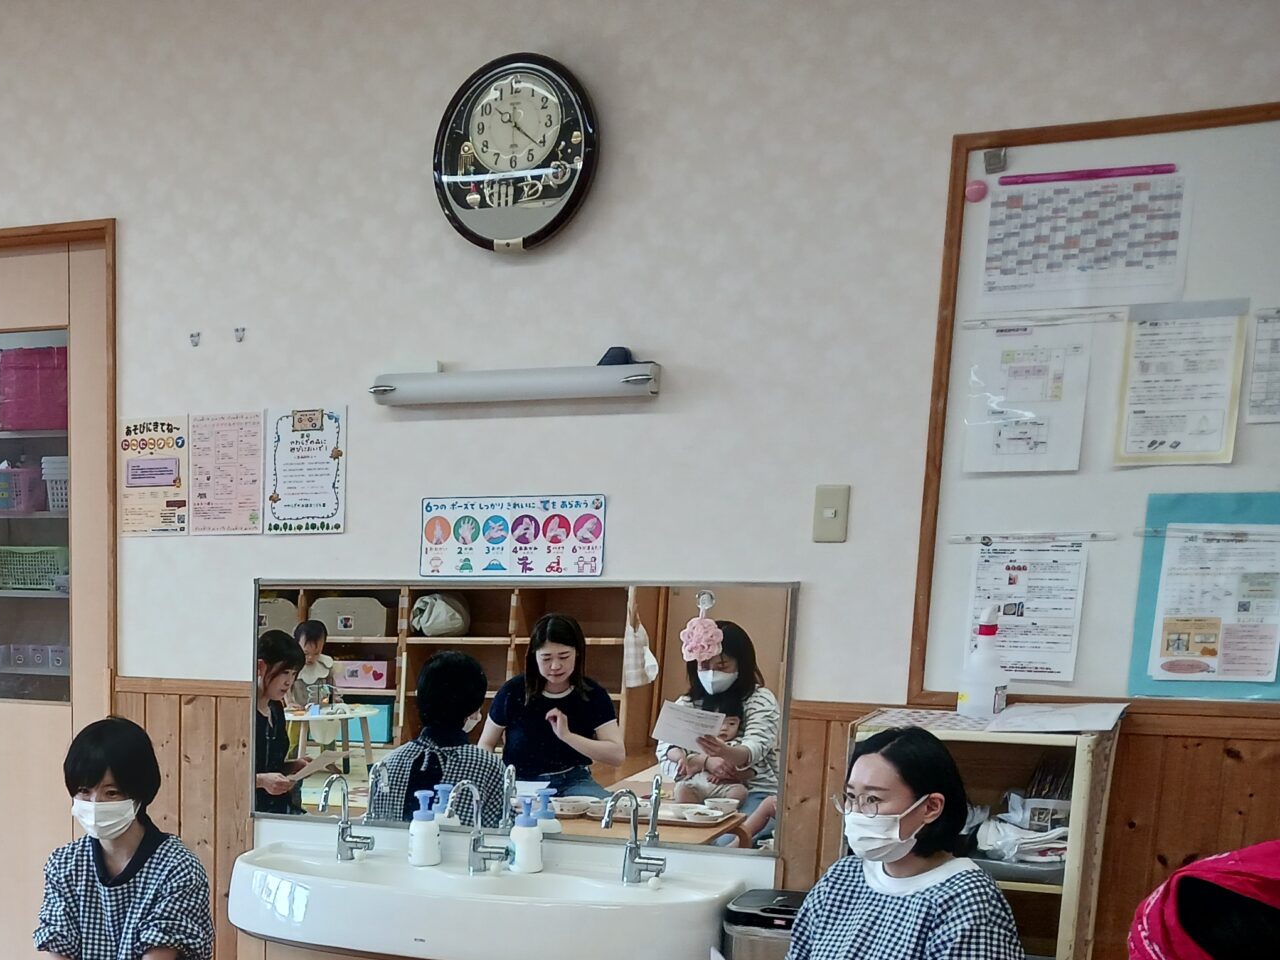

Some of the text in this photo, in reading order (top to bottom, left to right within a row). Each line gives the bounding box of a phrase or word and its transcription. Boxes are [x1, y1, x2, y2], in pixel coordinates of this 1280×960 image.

[481, 102, 492, 116] 10
[541, 97, 548, 109] 2
[545, 115, 552, 127] 3
[477, 122, 484, 135] 9
[482, 140, 489, 153] 8
[539, 134, 546, 148] 4
[493, 152, 500, 165] 7
[510, 155, 517, 168] 6
[527, 149, 534, 161] 5
[425, 501, 447, 513] 6つの
[560, 499, 589, 510] あらおう
